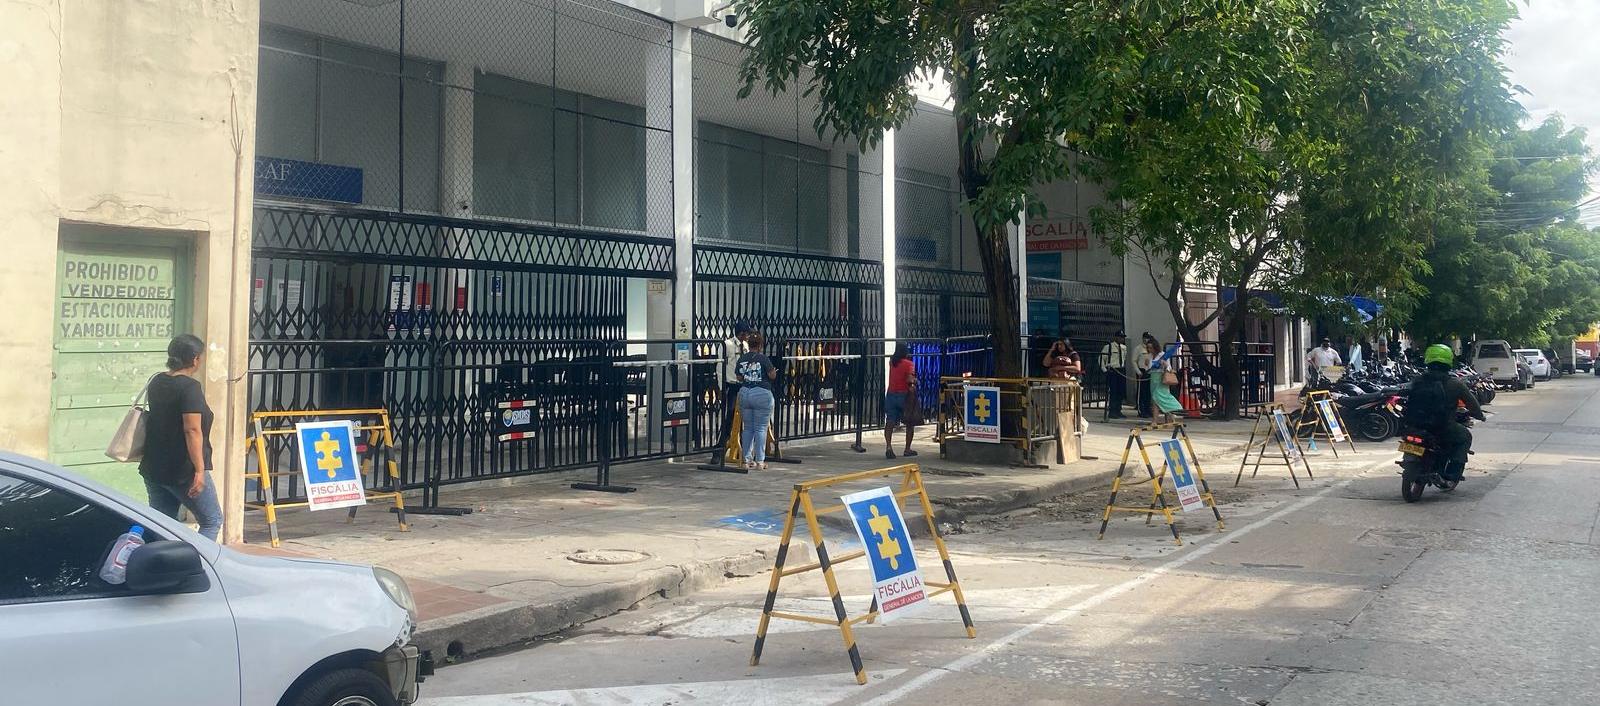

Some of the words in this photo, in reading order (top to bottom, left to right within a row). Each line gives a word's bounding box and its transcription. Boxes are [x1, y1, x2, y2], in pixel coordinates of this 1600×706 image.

[65, 261, 159, 281] PROHIBIDO
[68, 284, 173, 299] VENDEDORES
[61, 302, 174, 319] ESTACIONARIOS
